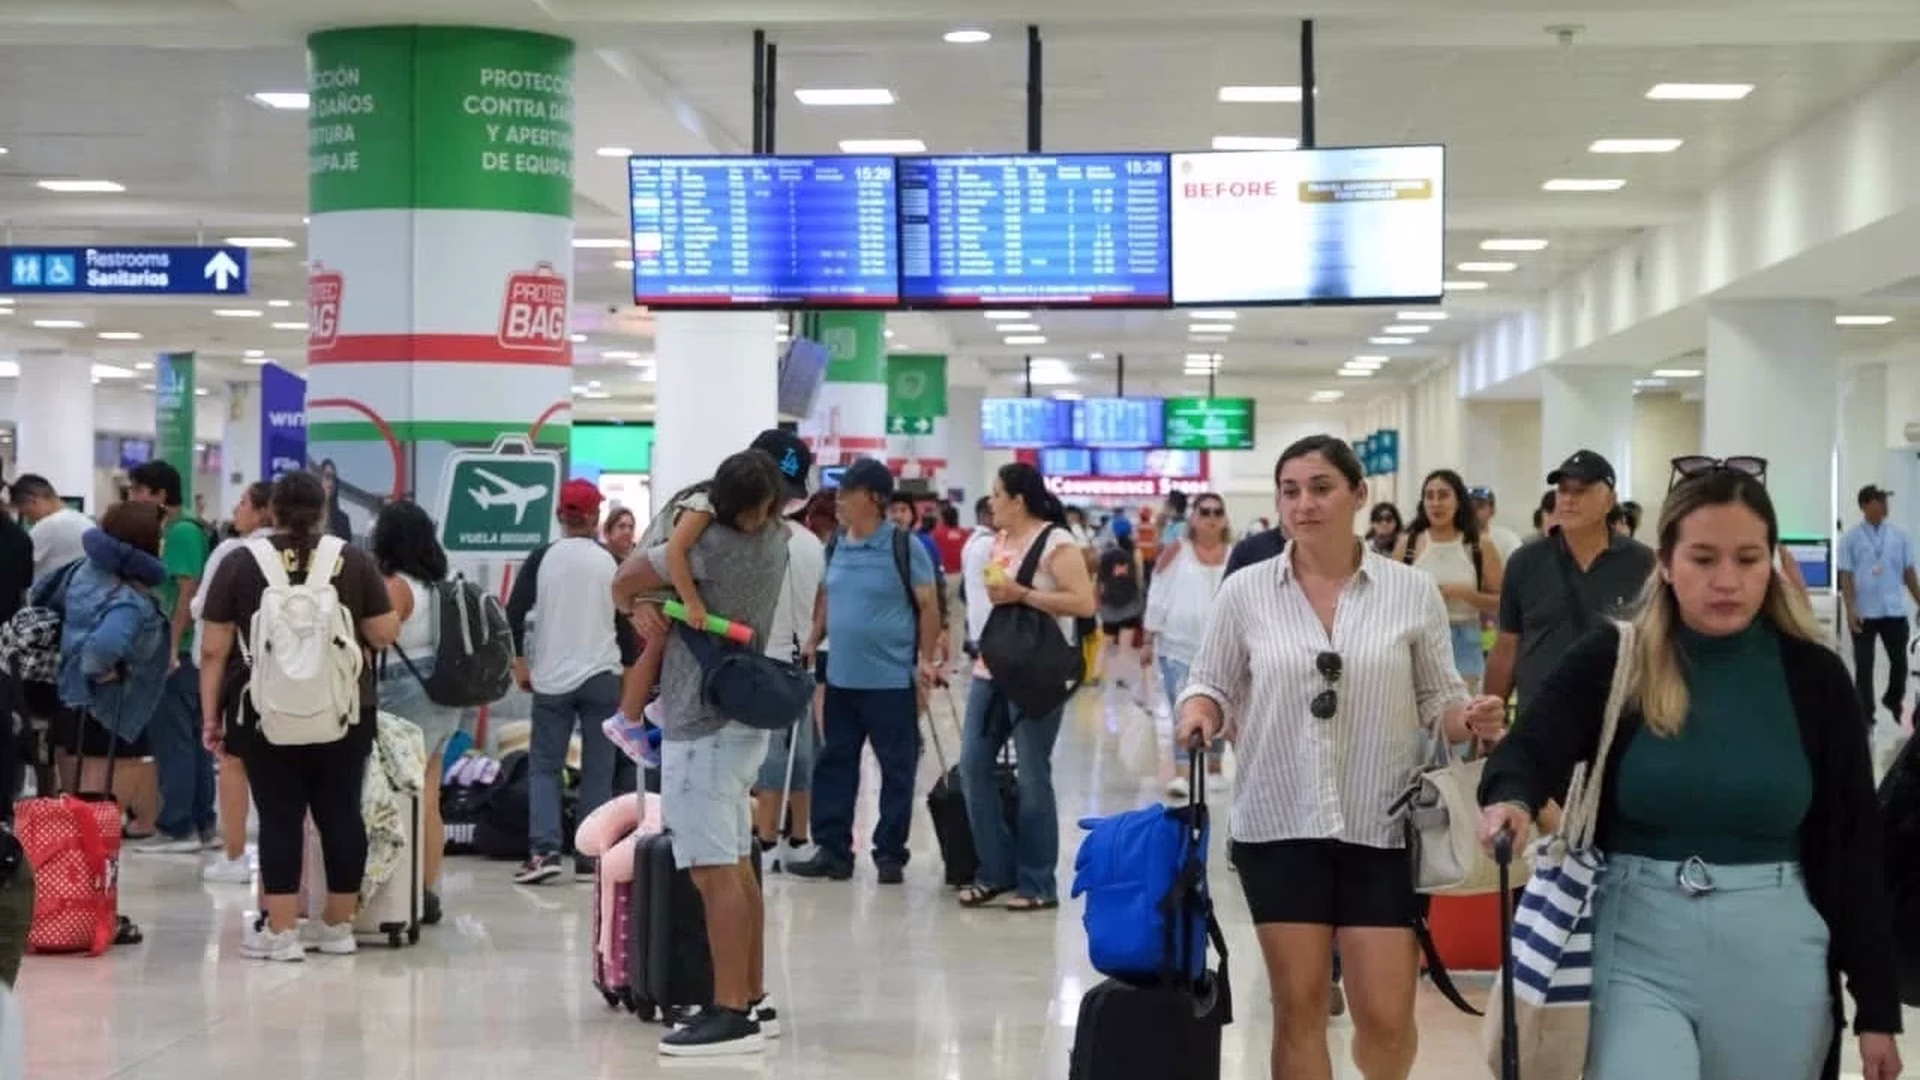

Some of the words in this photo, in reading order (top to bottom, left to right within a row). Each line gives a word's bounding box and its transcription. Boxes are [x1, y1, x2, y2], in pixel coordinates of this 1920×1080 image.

[463, 94, 545, 118] CONTRA
[485, 123, 500, 142] Y
[482, 152, 510, 172] DE
[1184, 181, 1277, 198] BEFORE
[86, 249, 169, 267] Restrooms
[87, 269, 169, 286] Sanitarios
[507, 304, 563, 340] BAG
[459, 532, 498, 543] VUELA
